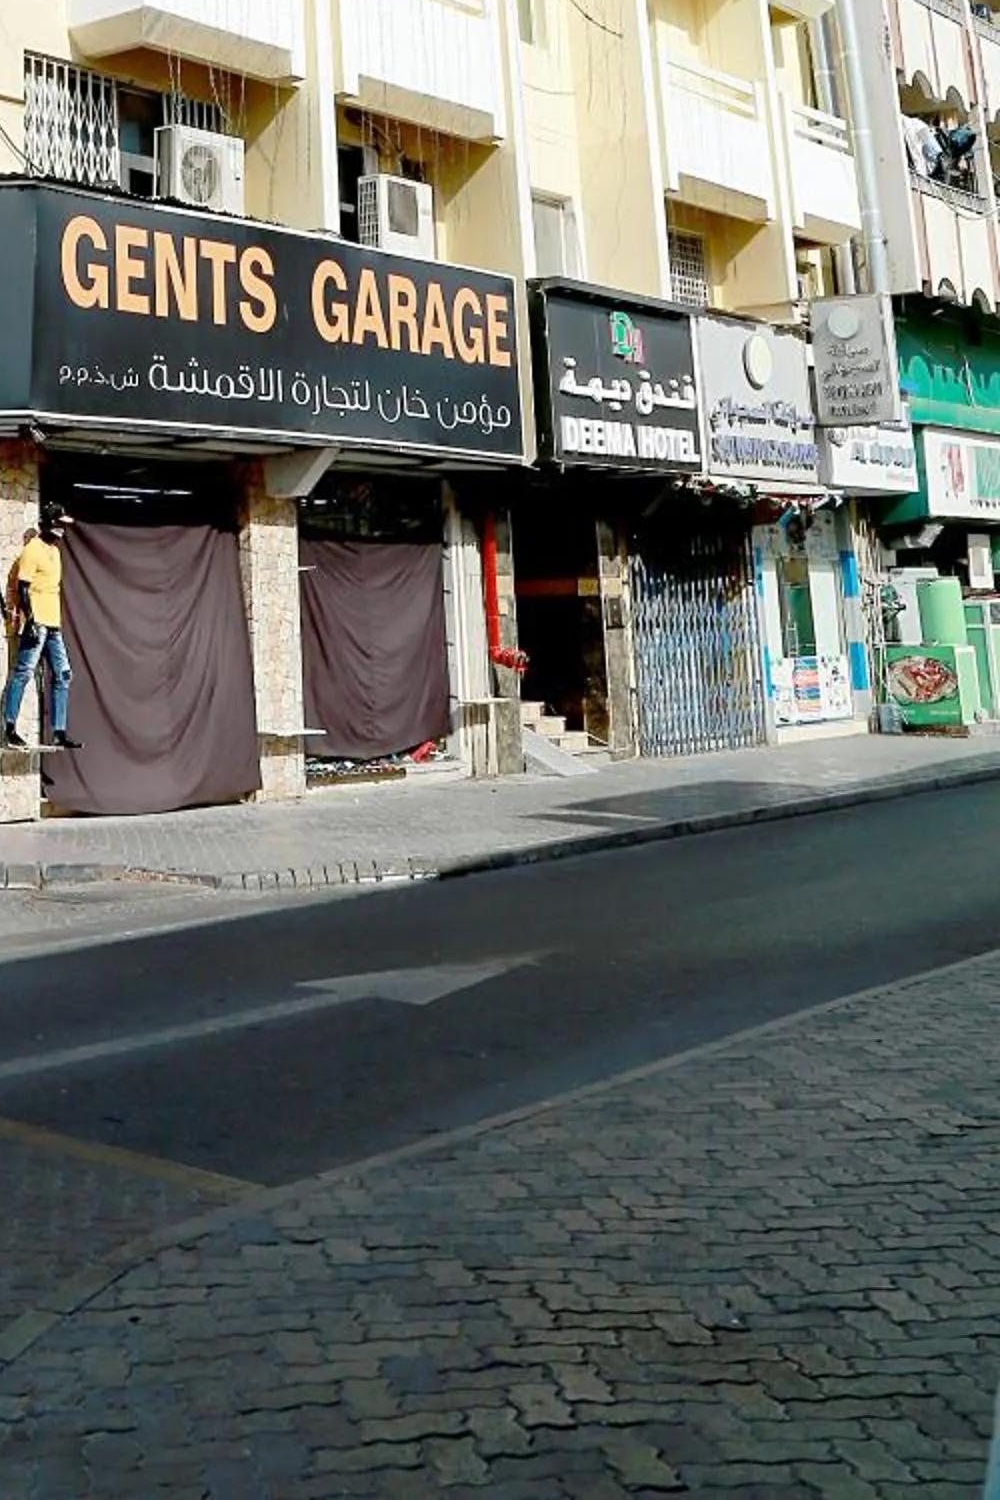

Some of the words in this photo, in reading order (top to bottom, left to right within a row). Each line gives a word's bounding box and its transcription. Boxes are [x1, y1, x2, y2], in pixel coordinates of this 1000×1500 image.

[60, 213, 278, 334] GENTS
[311, 258, 512, 368] GARAGE
[149, 354, 284, 403] الاقمشة
[291, 371, 372, 417] لتجارة
[559, 356, 633, 412] ديمة
[635, 369, 696, 416] فندق
[377, 384, 431, 423] خان
[436, 393, 512, 435] مؤمن
[560, 414, 637, 457] DEEMA
[637, 424, 702, 464] HOTEL
